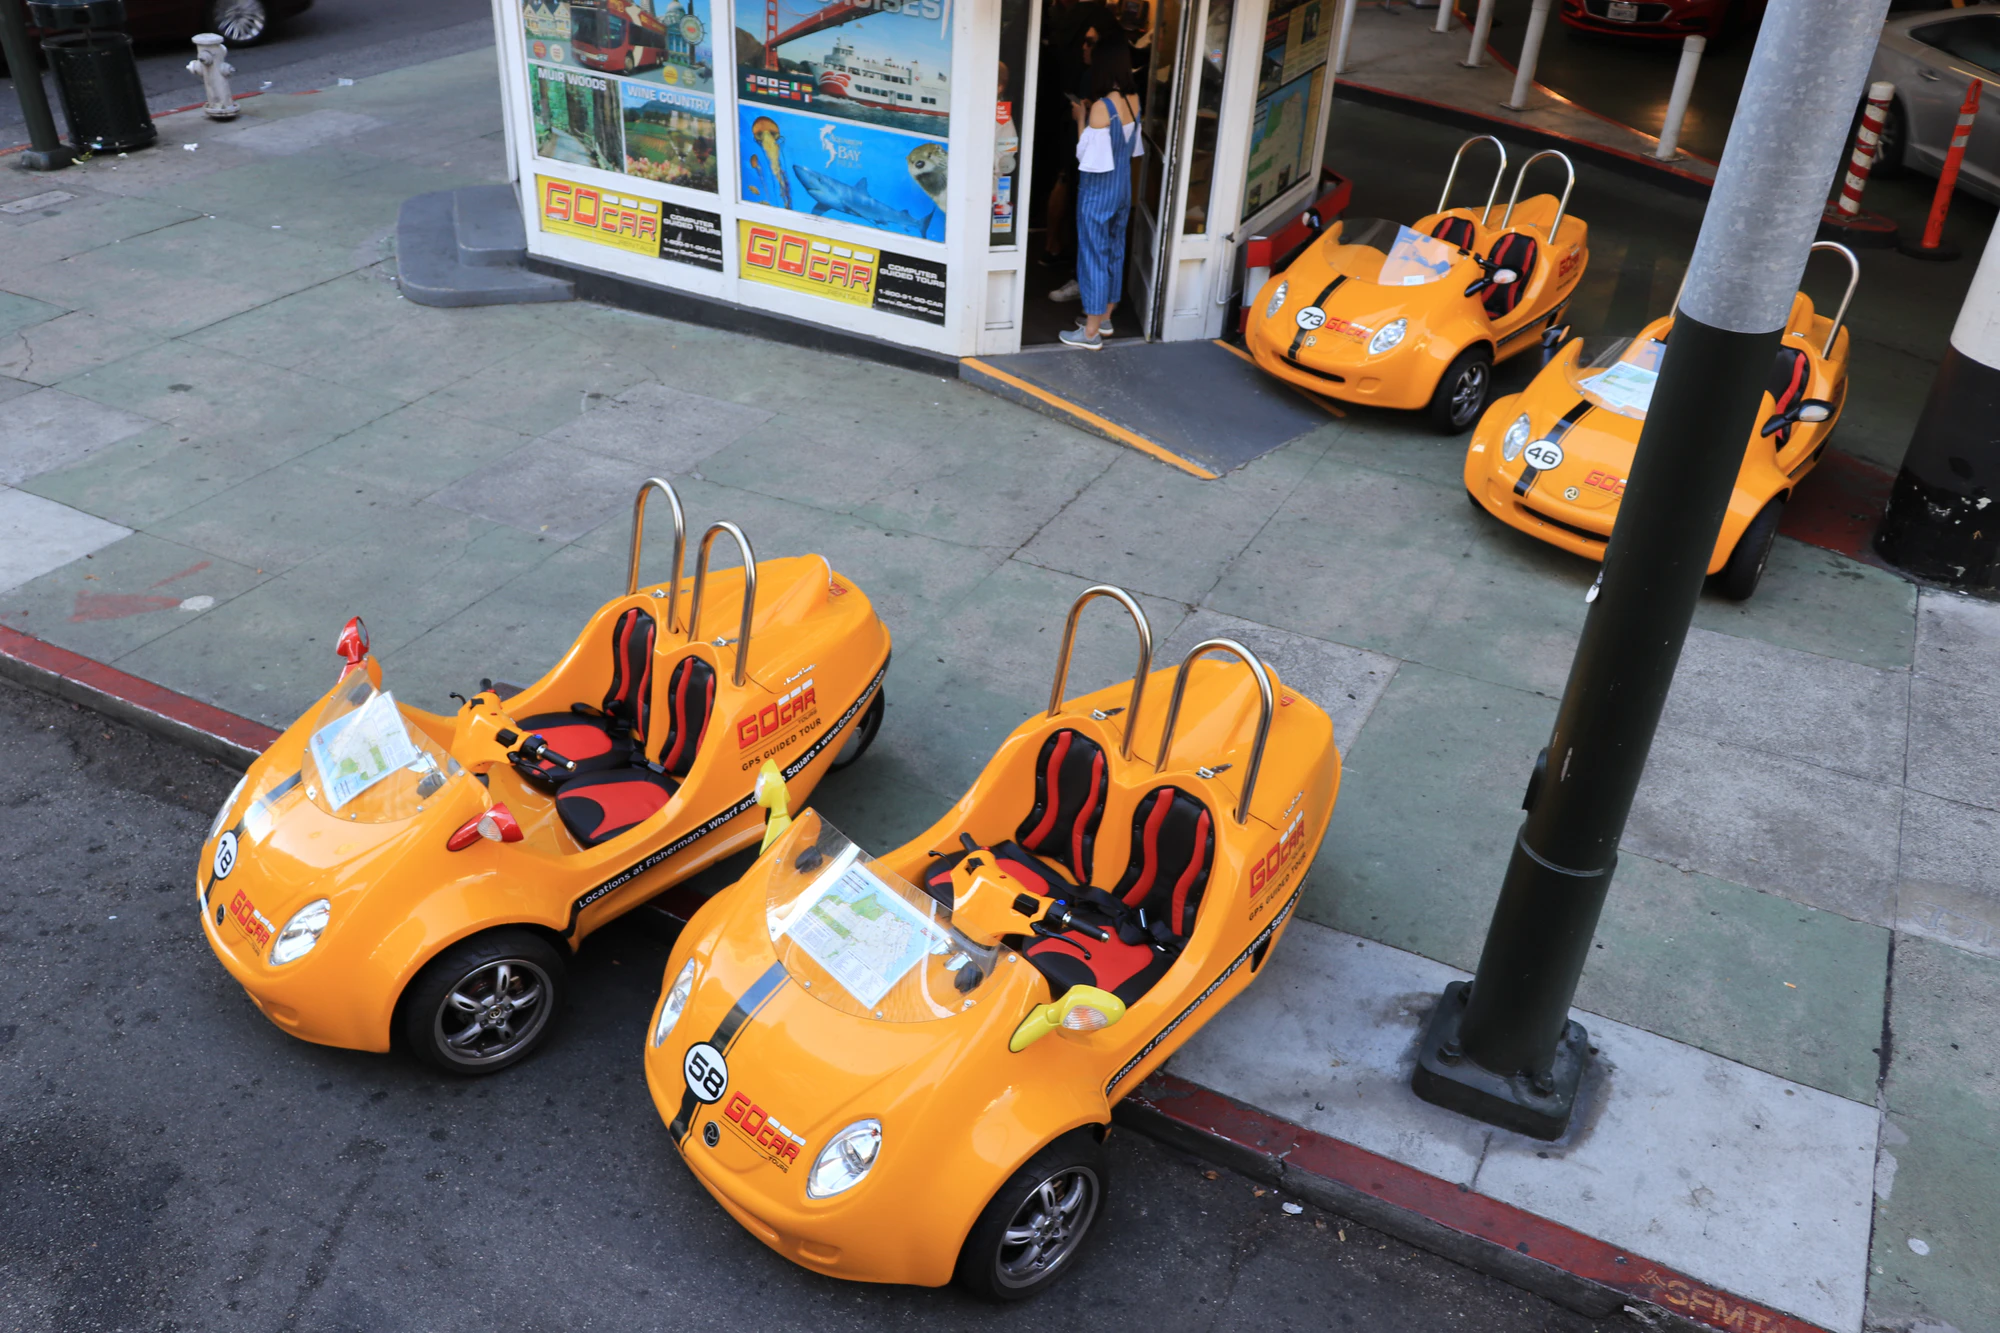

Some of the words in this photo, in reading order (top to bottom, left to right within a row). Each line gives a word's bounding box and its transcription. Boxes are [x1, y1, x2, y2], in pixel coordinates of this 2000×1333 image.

[538, 67, 565, 83] MUIR
[566, 73, 607, 91] WOODS
[627, 85, 657, 101] WINE
[659, 92, 712, 111] COUNTRY
[879, 268, 914, 281] GUIDED
[915, 275, 946, 289] TOURS
[888, 263, 938, 280] COMPUTER
[1301, 311, 1324, 327] 73
[1527, 447, 1559, 466] 46
[1584, 469, 1627, 496] GOC
[741, 755, 761, 772] GPS
[763, 734, 797, 759] GUIDED
[799, 717, 822, 737] TOUR
[786, 749, 816, 779] Square
[217, 839, 233, 874] 18
[578, 873, 631, 909] Locations
[632, 865, 644, 876] at
[646, 827, 707, 868] Fisherman's
[708, 805, 738, 830] Wharf
[1248, 902, 1264, 921] GPS
[1265, 873, 1290, 905] GUIDED
[1232, 951, 1247, 972] and
[1248, 928, 1271, 954] Union
[1271, 897, 1295, 930] Square
[688, 1051, 725, 1099] 58
[767, 1156, 789, 1174] TOURS
